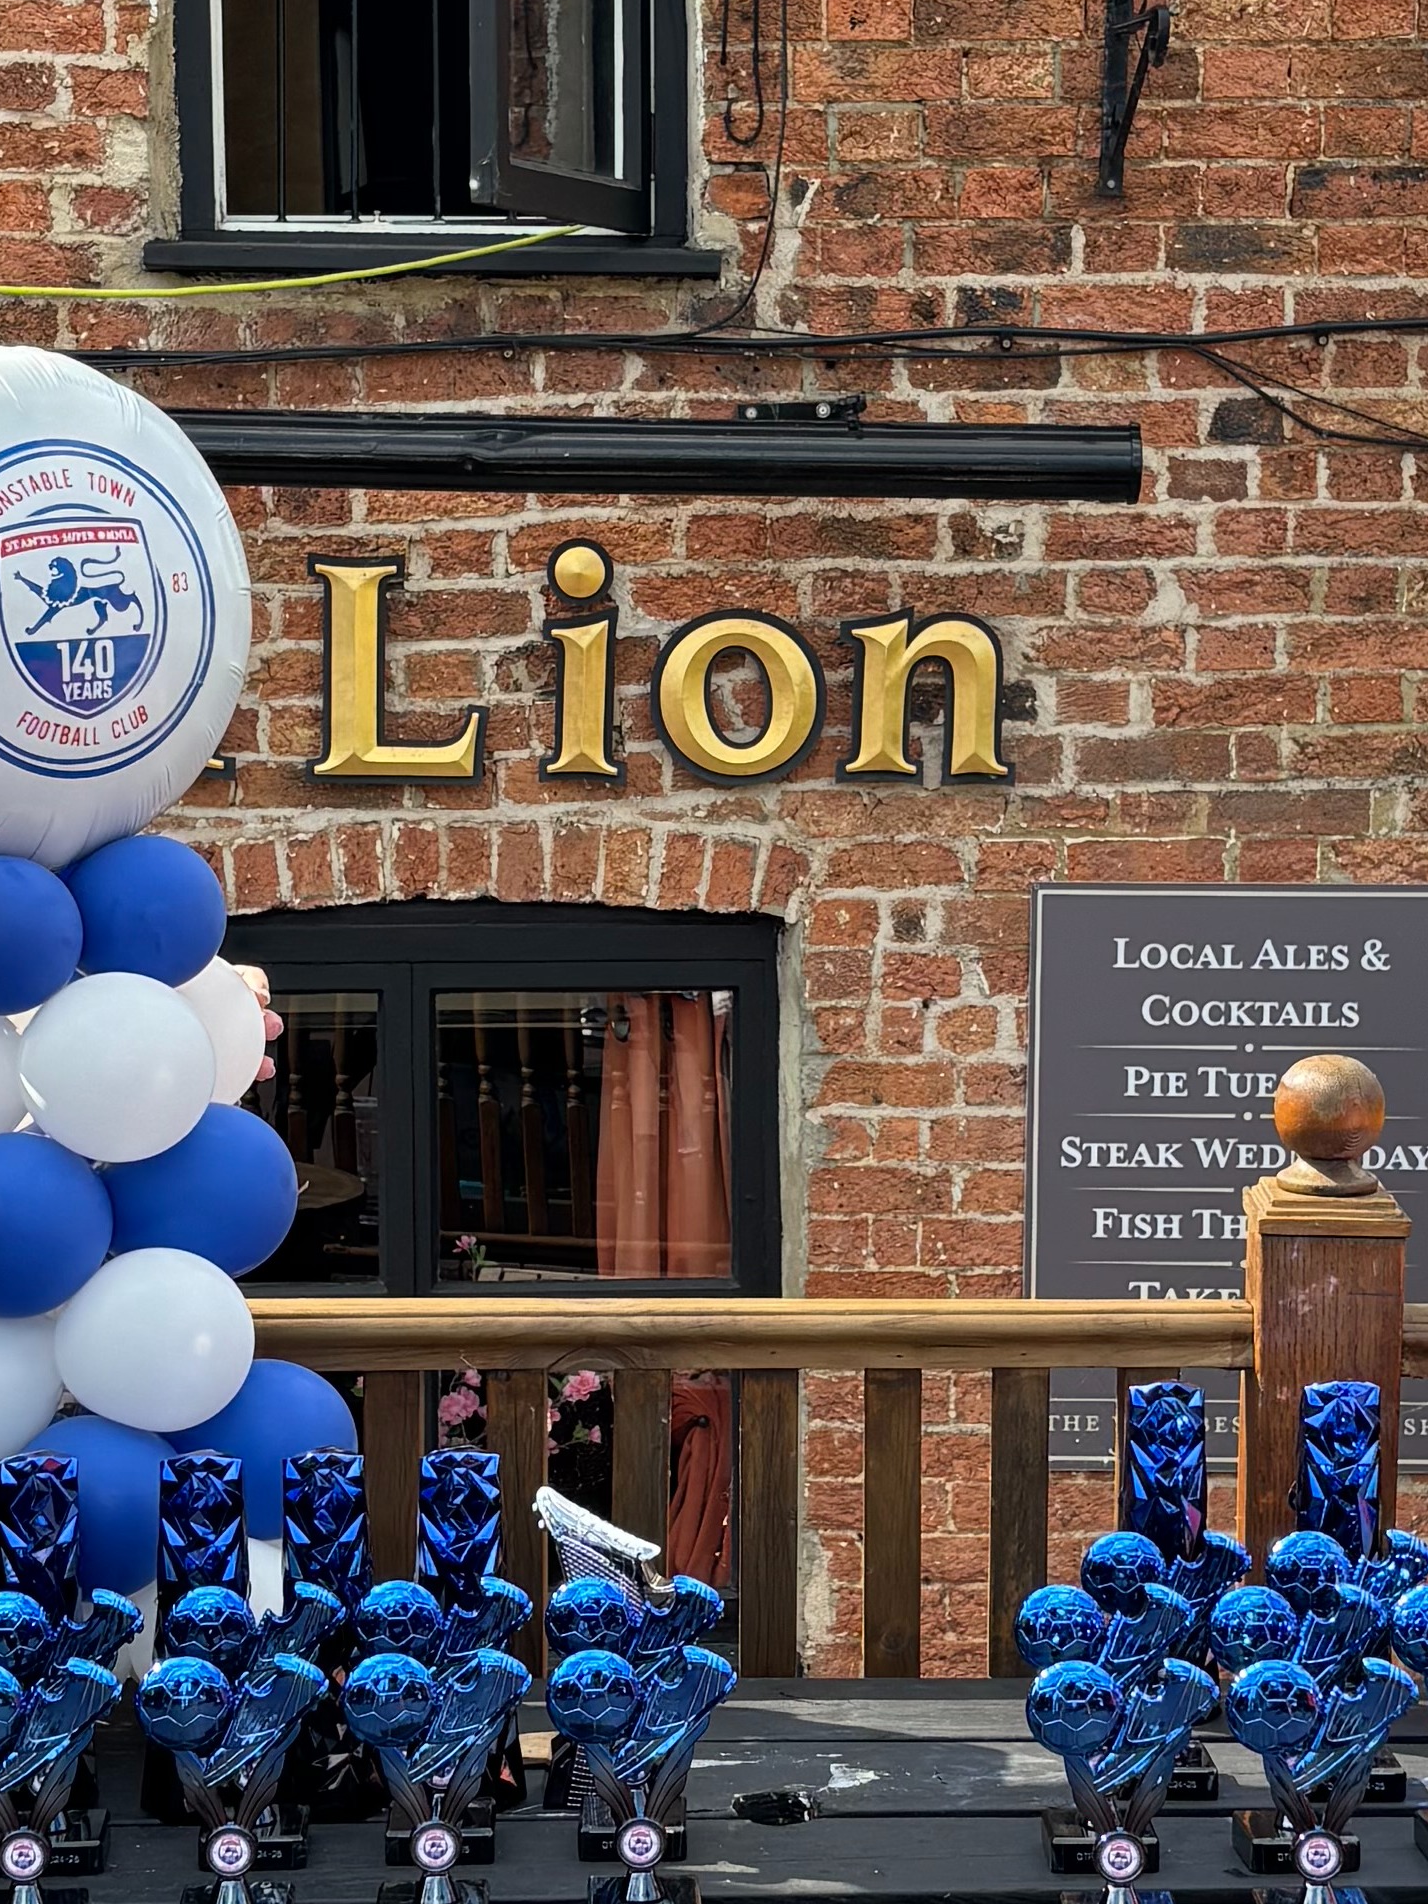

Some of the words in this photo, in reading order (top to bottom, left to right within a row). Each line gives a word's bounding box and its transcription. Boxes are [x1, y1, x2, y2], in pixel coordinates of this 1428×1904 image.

[87, 471, 137, 508] TOWN
[171, 571, 190, 593] 83
[56, 639, 116, 681] 140
[307, 538, 1015, 786] Lion
[61, 679, 114, 703] YEARS
[16, 710, 101, 747] FOOTBALL
[111, 704, 150, 740] CLUB
[1112, 937, 1244, 972] LOCAL
[1251, 938, 1350, 972] ALES
[1360, 938, 1391, 973] &
[1140, 994, 1361, 1030] COCKTAILS
[1123, 1065, 1188, 1098] PIE
[1060, 1135, 1184, 1169] STEAK
[1091, 1207, 1183, 1240] FISH
[1048, 1414, 1100, 1432] THE
